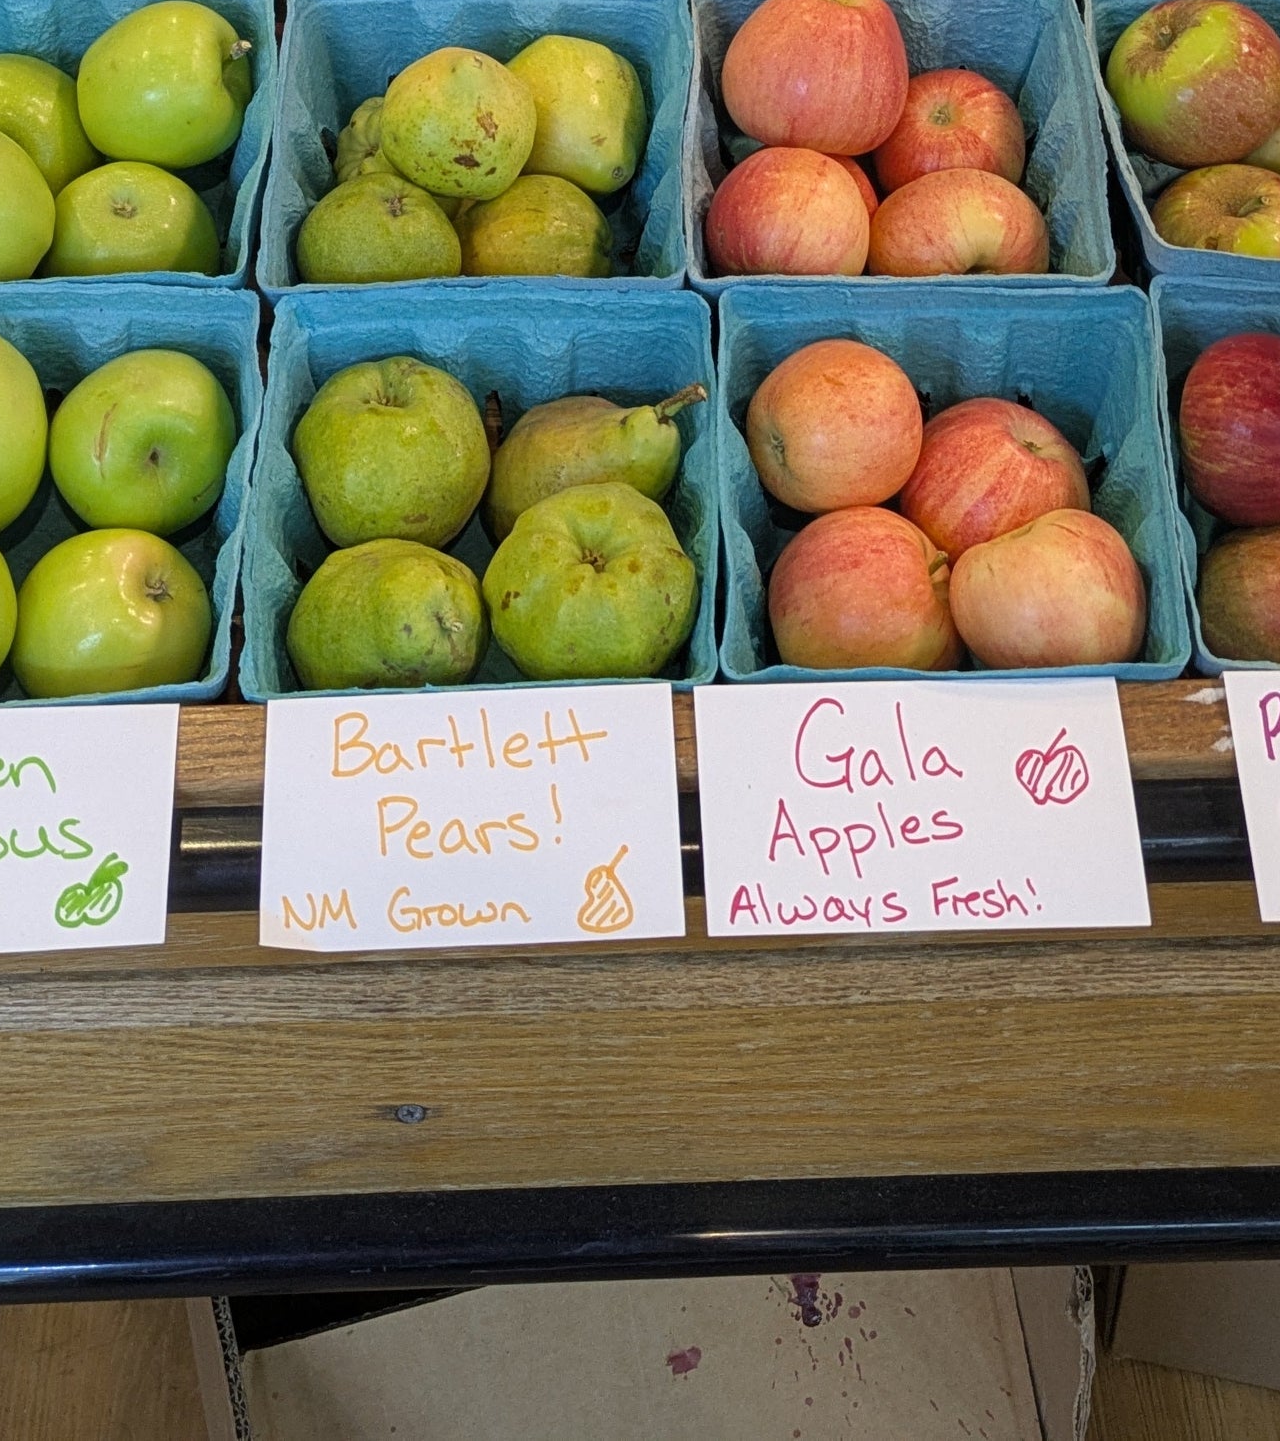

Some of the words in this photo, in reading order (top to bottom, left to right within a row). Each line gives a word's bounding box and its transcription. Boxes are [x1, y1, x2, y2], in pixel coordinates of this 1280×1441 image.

[331, 708, 609, 778] Bartlett
[794, 696, 964, 794] Gala
[376, 783, 564, 859] Pears!
[767, 798, 965, 879] Apples
[281, 888, 358, 931] NM
[386, 885, 532, 933] Grown
[728, 882, 909, 928] Always
[930, 876, 1045, 920] Fresh!
